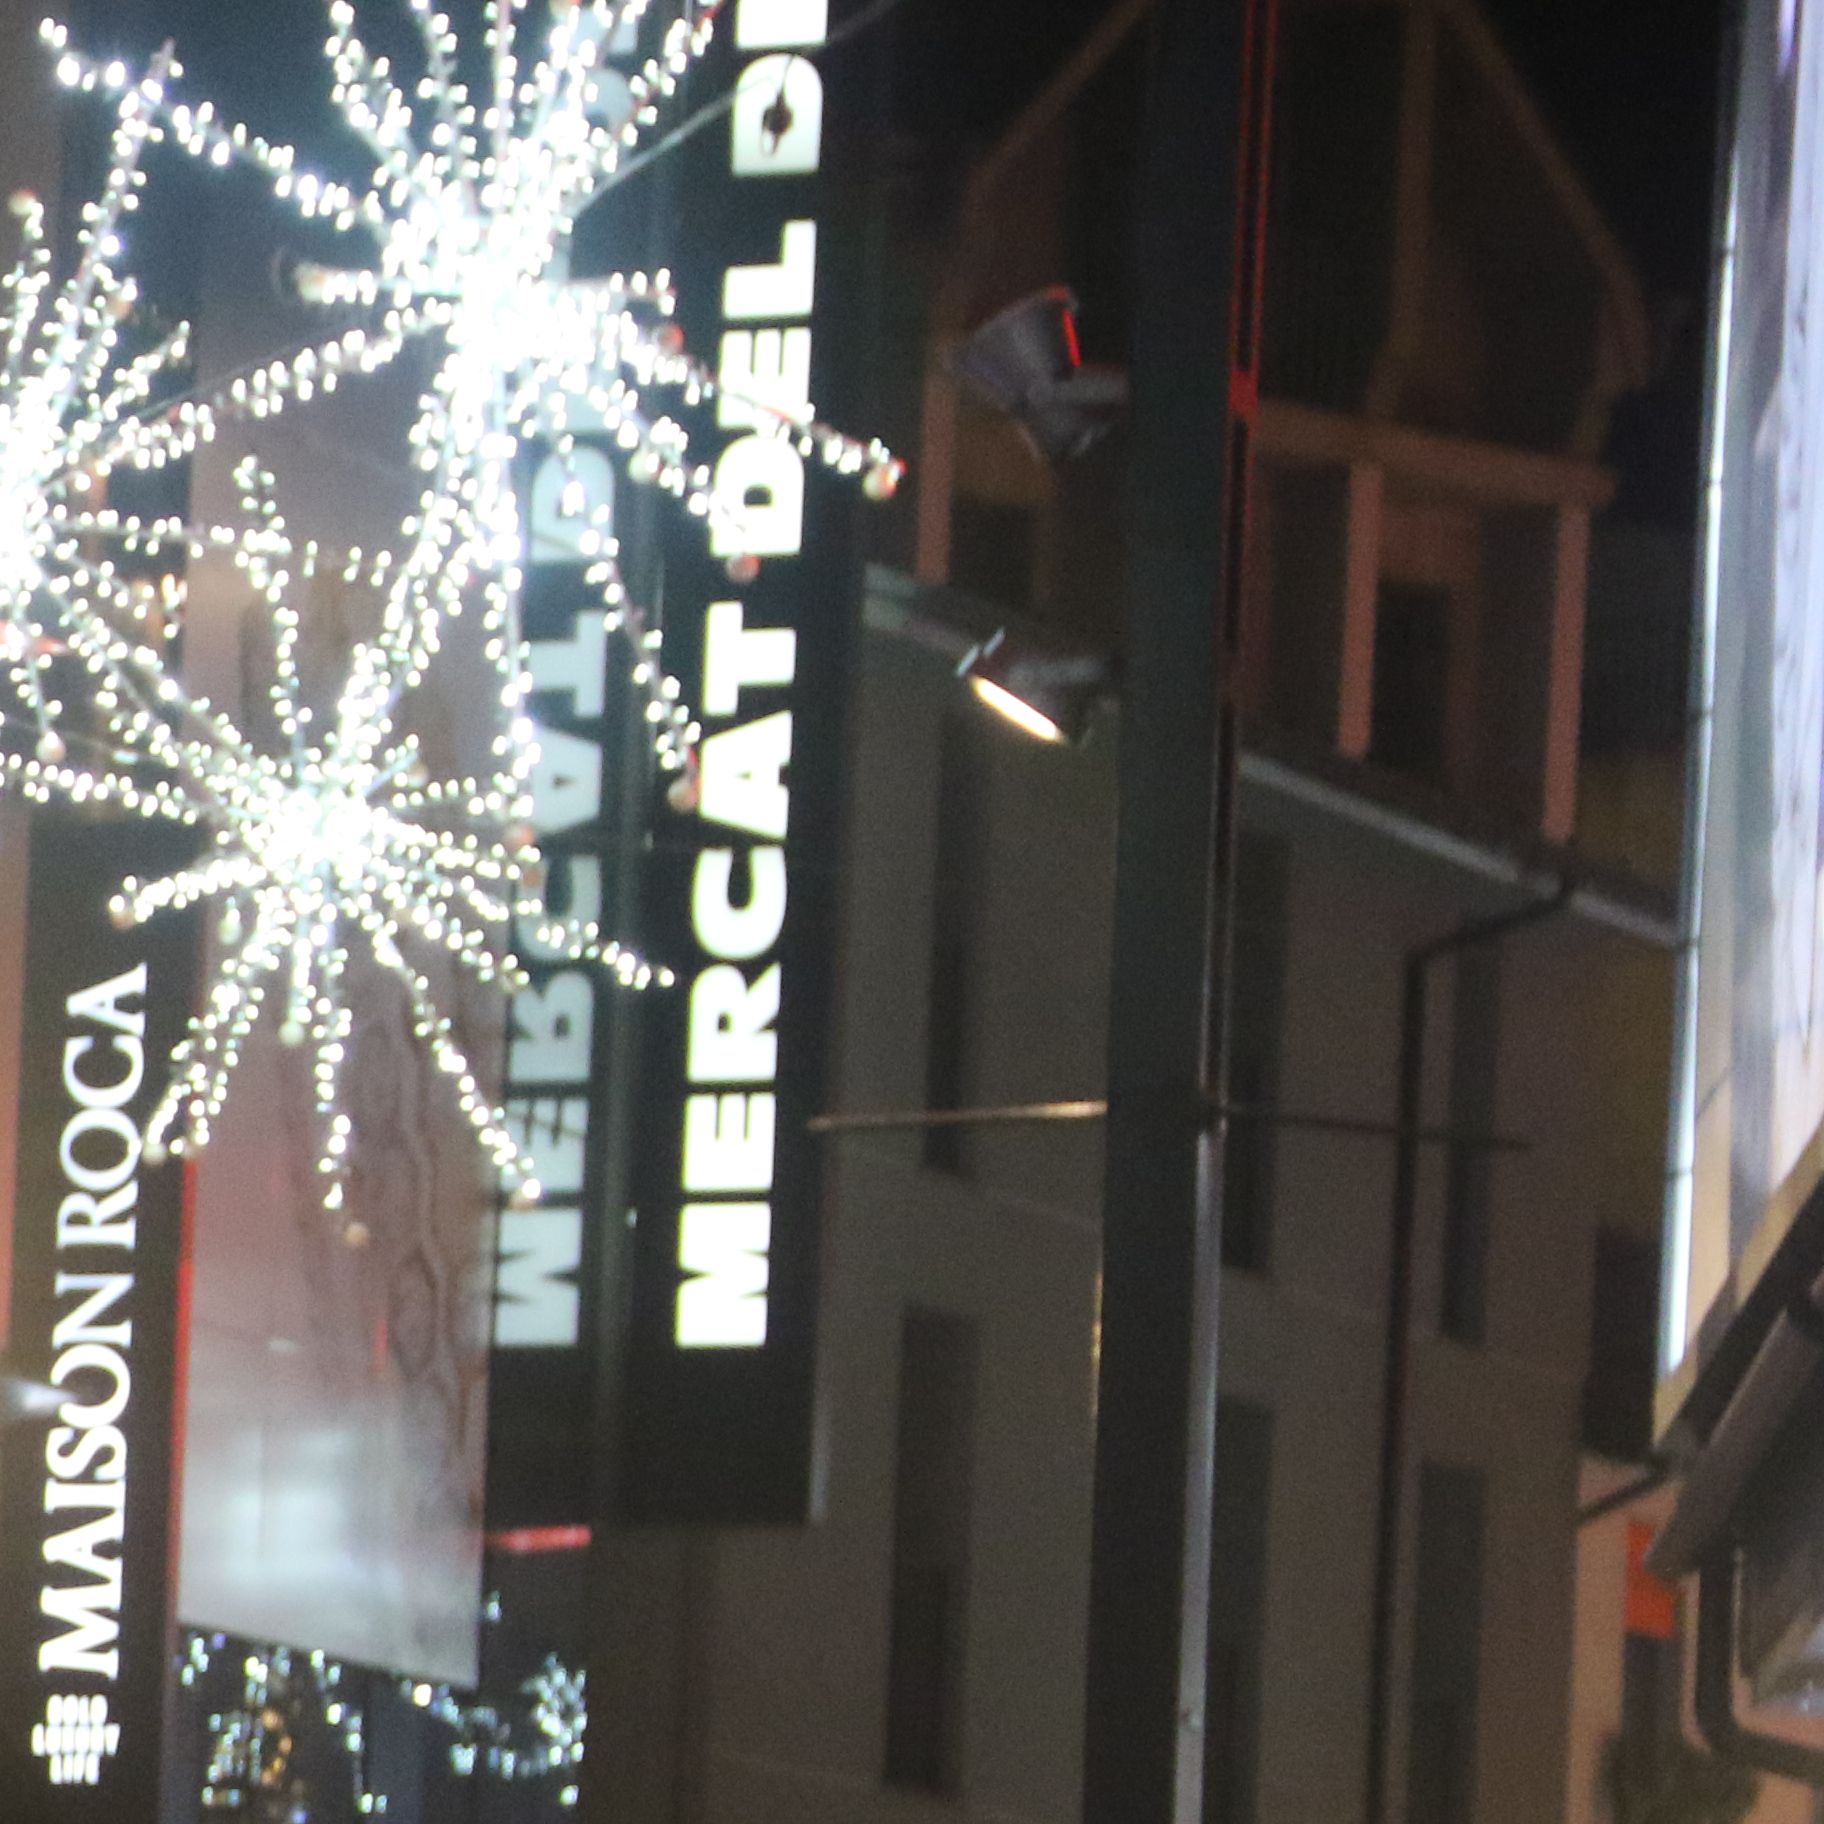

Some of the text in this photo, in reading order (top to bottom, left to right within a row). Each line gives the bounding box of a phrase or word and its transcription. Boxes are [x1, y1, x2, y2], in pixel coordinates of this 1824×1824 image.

[711, 218, 817, 561] DEL
[37, 962, 149, 1682] MAISON ROCA
[675, 602, 796, 1349] MERCAT
